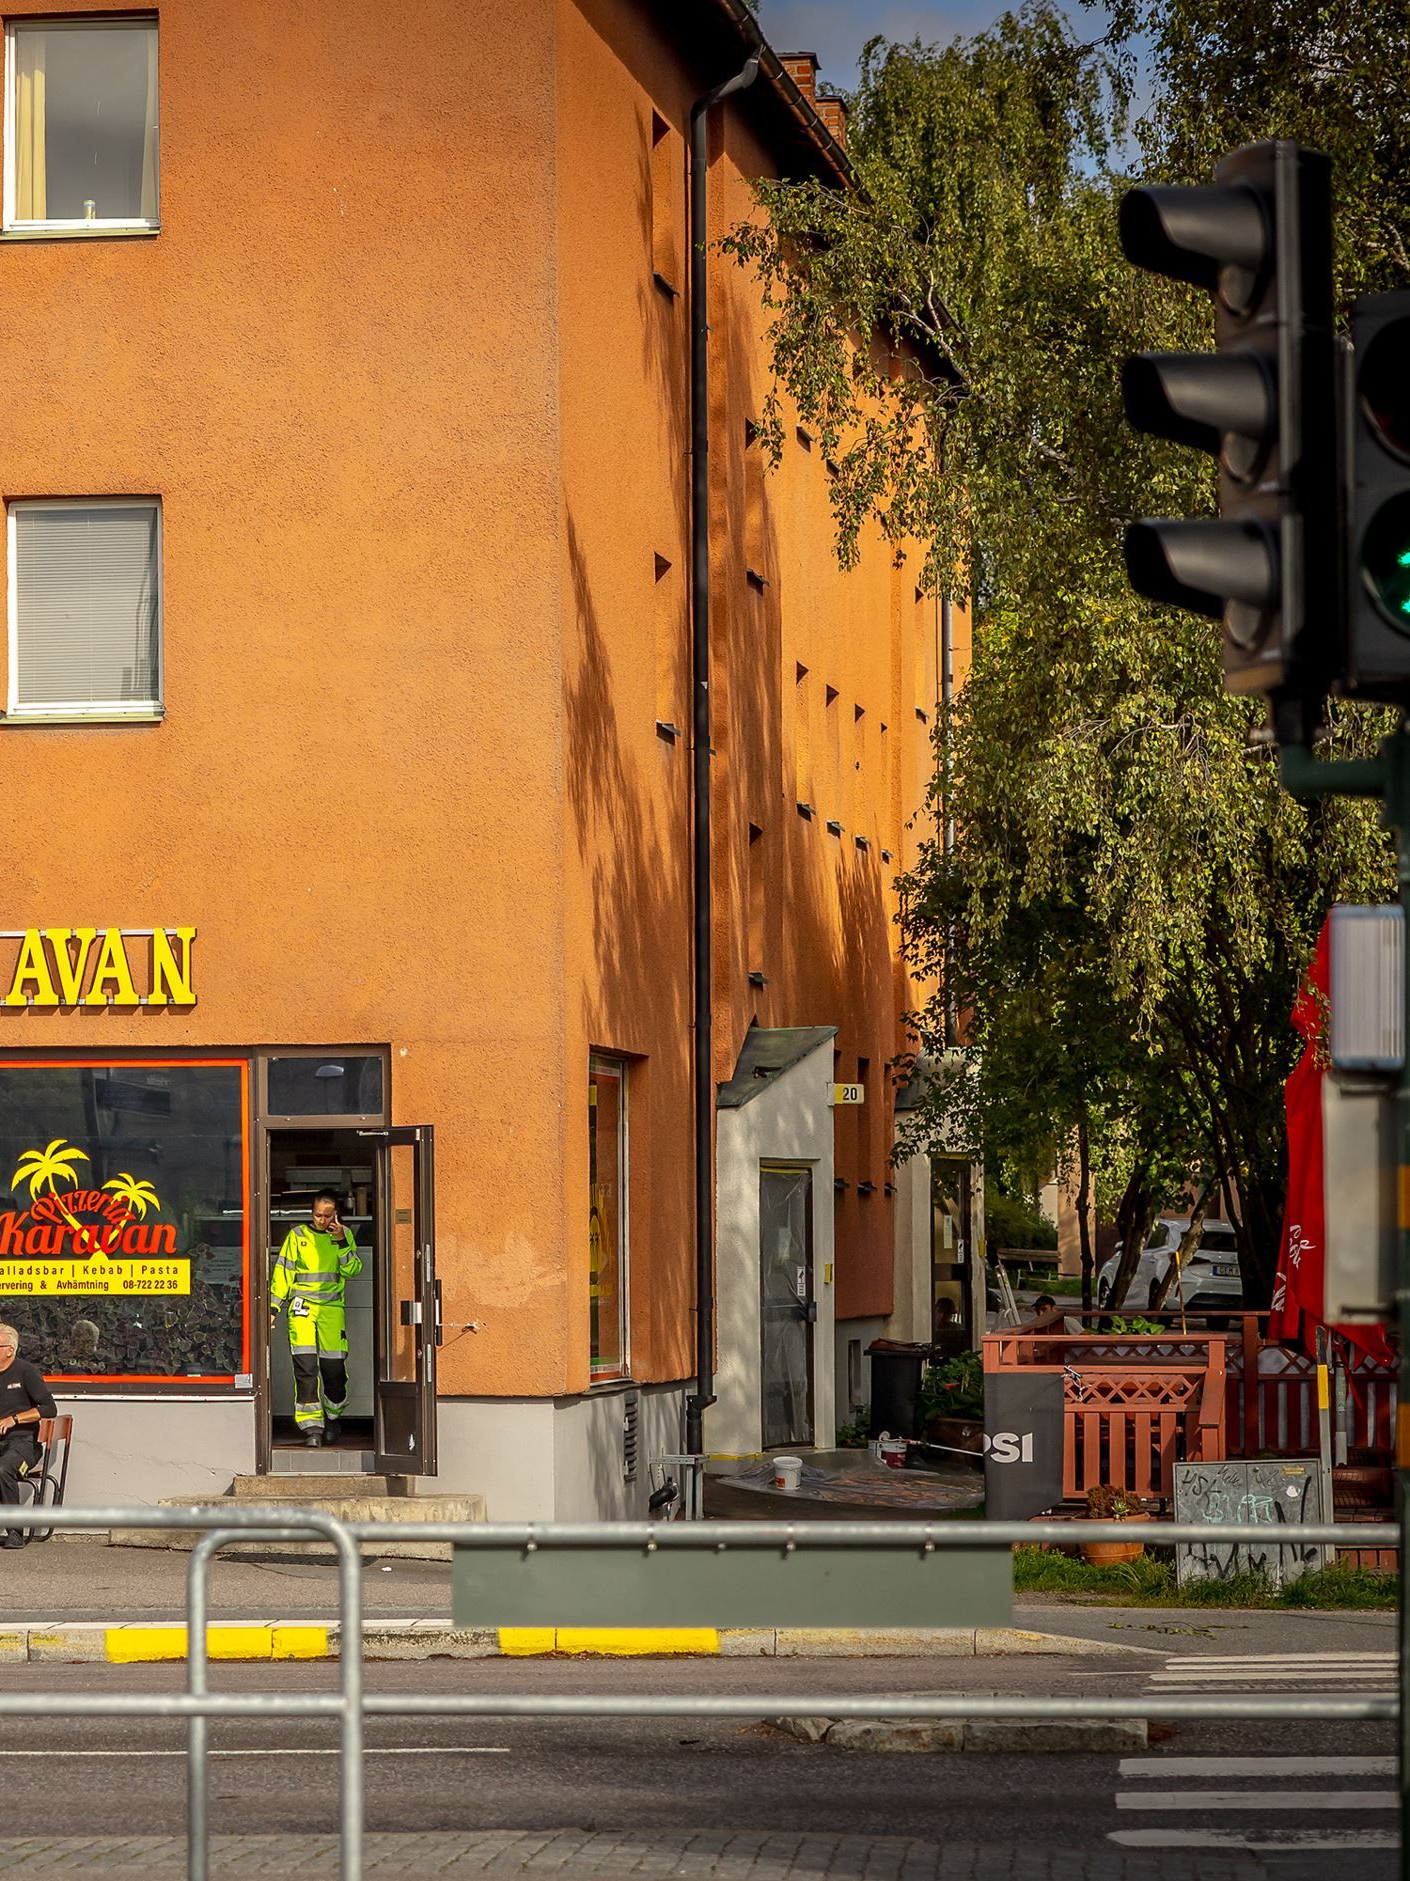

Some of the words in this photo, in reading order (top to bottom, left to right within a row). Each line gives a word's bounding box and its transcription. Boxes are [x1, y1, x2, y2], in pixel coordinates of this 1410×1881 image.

[842, 1087, 858, 1101] 20
[30, 1190, 137, 1225] Pizzeria
[82, 1264, 123, 1275] Kebab
[141, 1264, 178, 1275] Pasta
[40, 1280, 47, 1290] &
[56, 1279, 109, 1292] Avhämtning
[123, 1280, 153, 1290] 08-722
[154, 1280, 165, 1290] 22
[167, 1280, 178, 1290] 36
